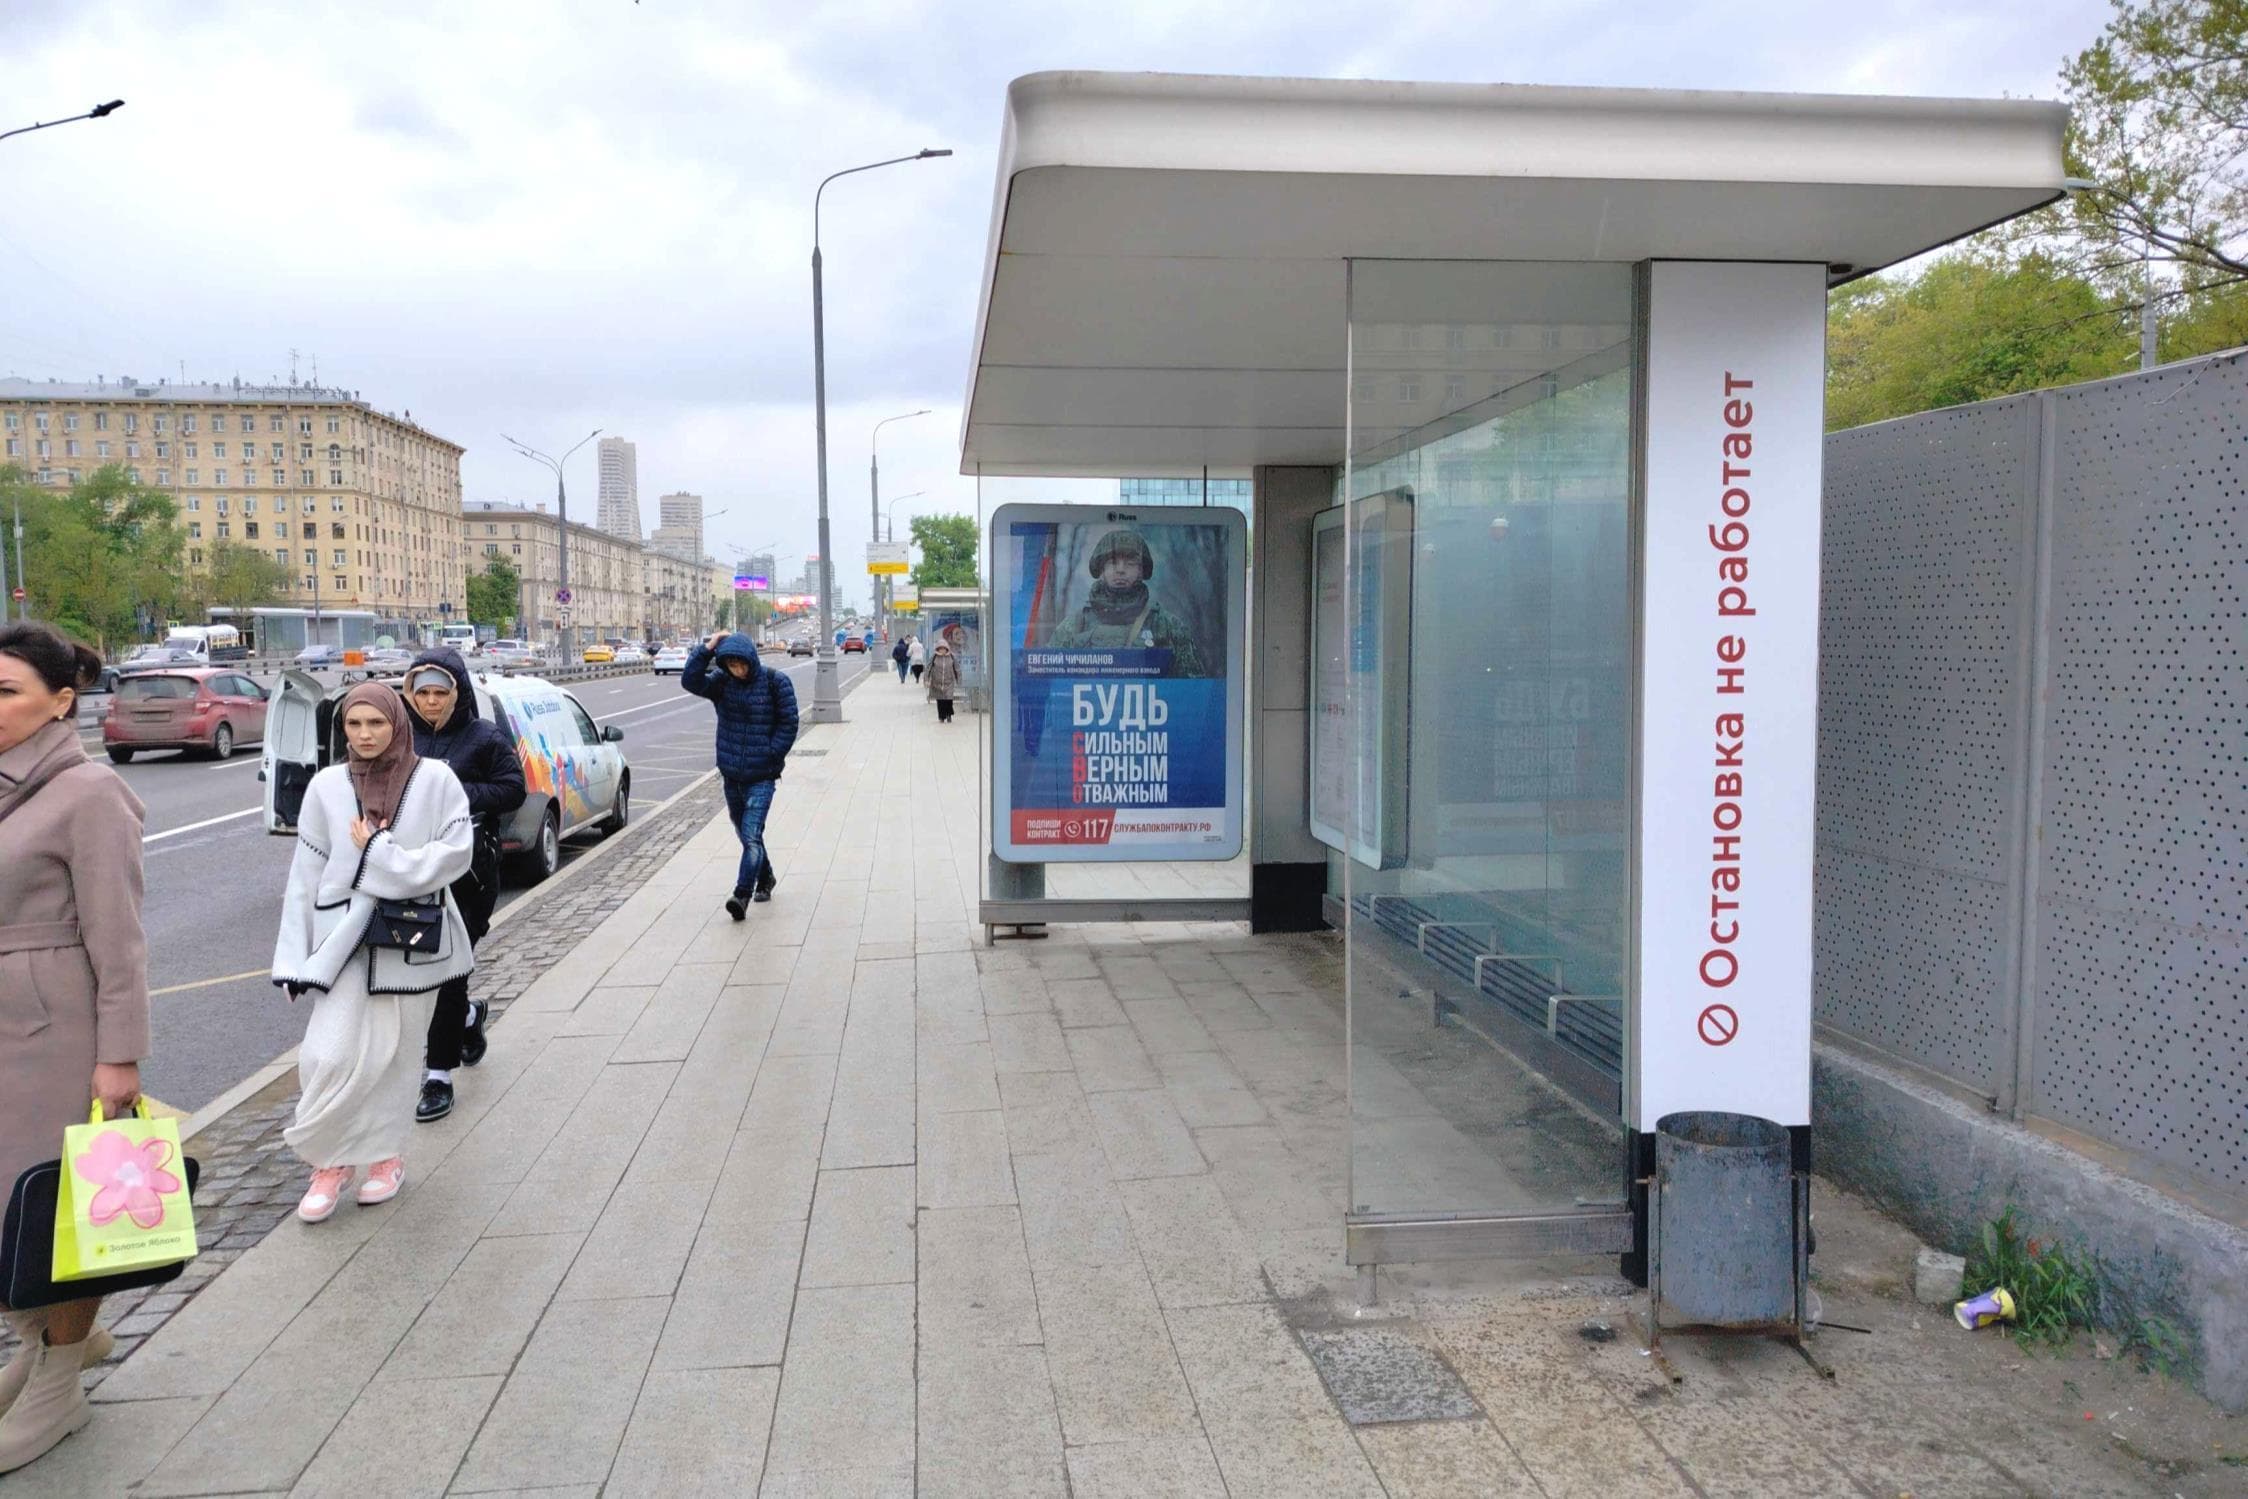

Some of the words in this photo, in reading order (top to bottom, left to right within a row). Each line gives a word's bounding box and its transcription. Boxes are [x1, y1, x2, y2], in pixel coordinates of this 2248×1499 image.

[1708, 371, 1756, 616] работает
[1028, 652, 1064, 665] ЕВГЕНИЙ
[1716, 635, 1745, 693] не
[1073, 684, 1168, 731] БУДЬ
[1072, 731, 1168, 754] СИЛЬНЫМ
[1072, 755, 1168, 782] ВЕРНЫМ
[1072, 783, 1168, 804] ОТВАЖНЫМ
[1027, 819, 1061, 829] ПОДПИШИ
[1027, 829, 1061, 838] КОНТРАКТ
[1083, 819, 1108, 838] 117
[1699, 713, 1743, 987] Остановка
